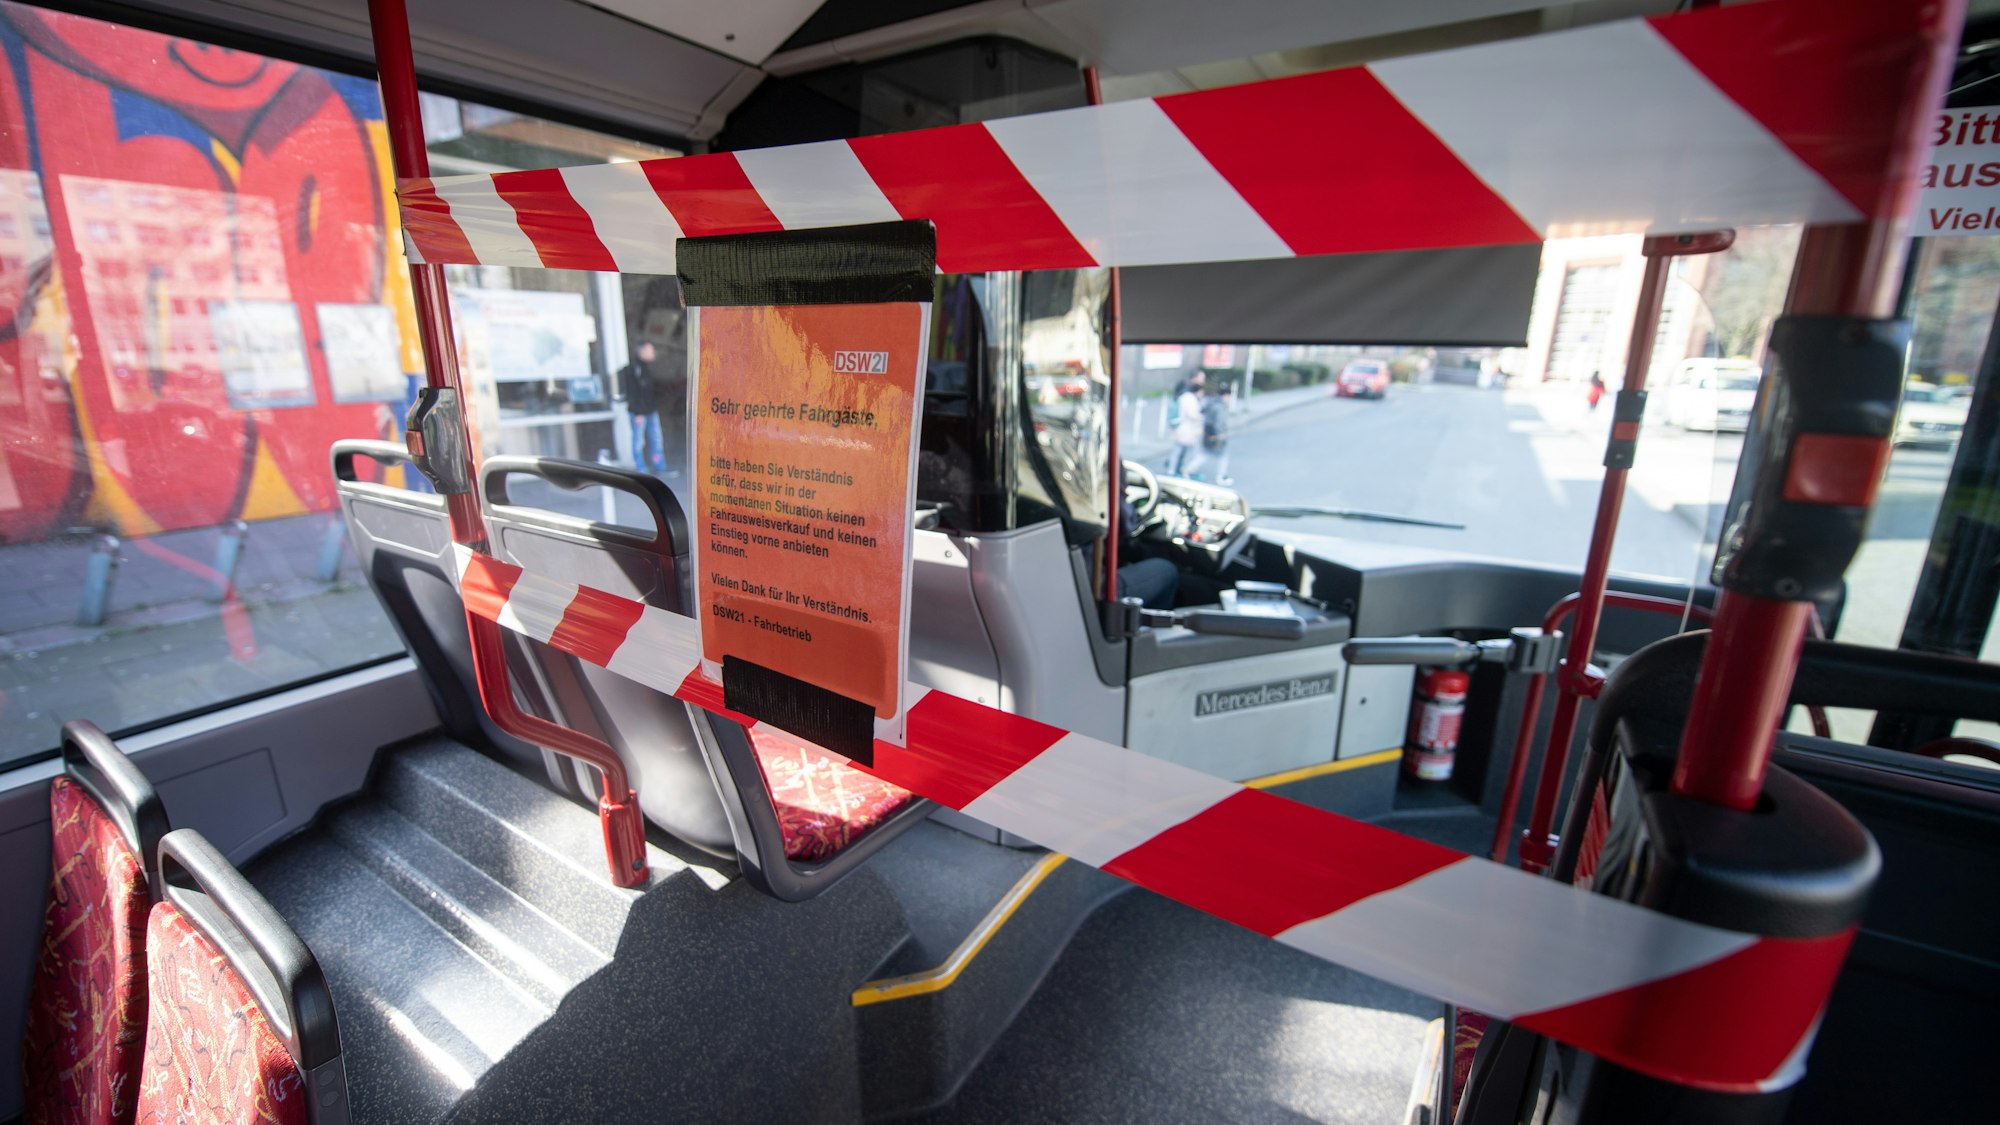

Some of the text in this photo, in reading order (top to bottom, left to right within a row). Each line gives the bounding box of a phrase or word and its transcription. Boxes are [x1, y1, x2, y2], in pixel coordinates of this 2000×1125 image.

[711, 397, 878, 430] Sehr geehrte Fahrgäste,
[710, 455, 854, 486] bitte haben Sie Verständnis
[710, 474, 816, 500] dafür, dass wir in der
[710, 491, 866, 527] momentanen Situation keinen
[710, 506, 877, 549] Fahrausweisverkauf und keinen
[711, 523, 829, 558] Einstieg vorne anbieten
[711, 540, 748, 559] können.
[711, 572, 872, 624] Vielen Dank für Ihr Verständnis.
[712, 604, 745, 624] DSW21
[754, 615, 812, 642] Fahrbetrieb
[1199, 678, 1330, 715] Mercedes-Benz
